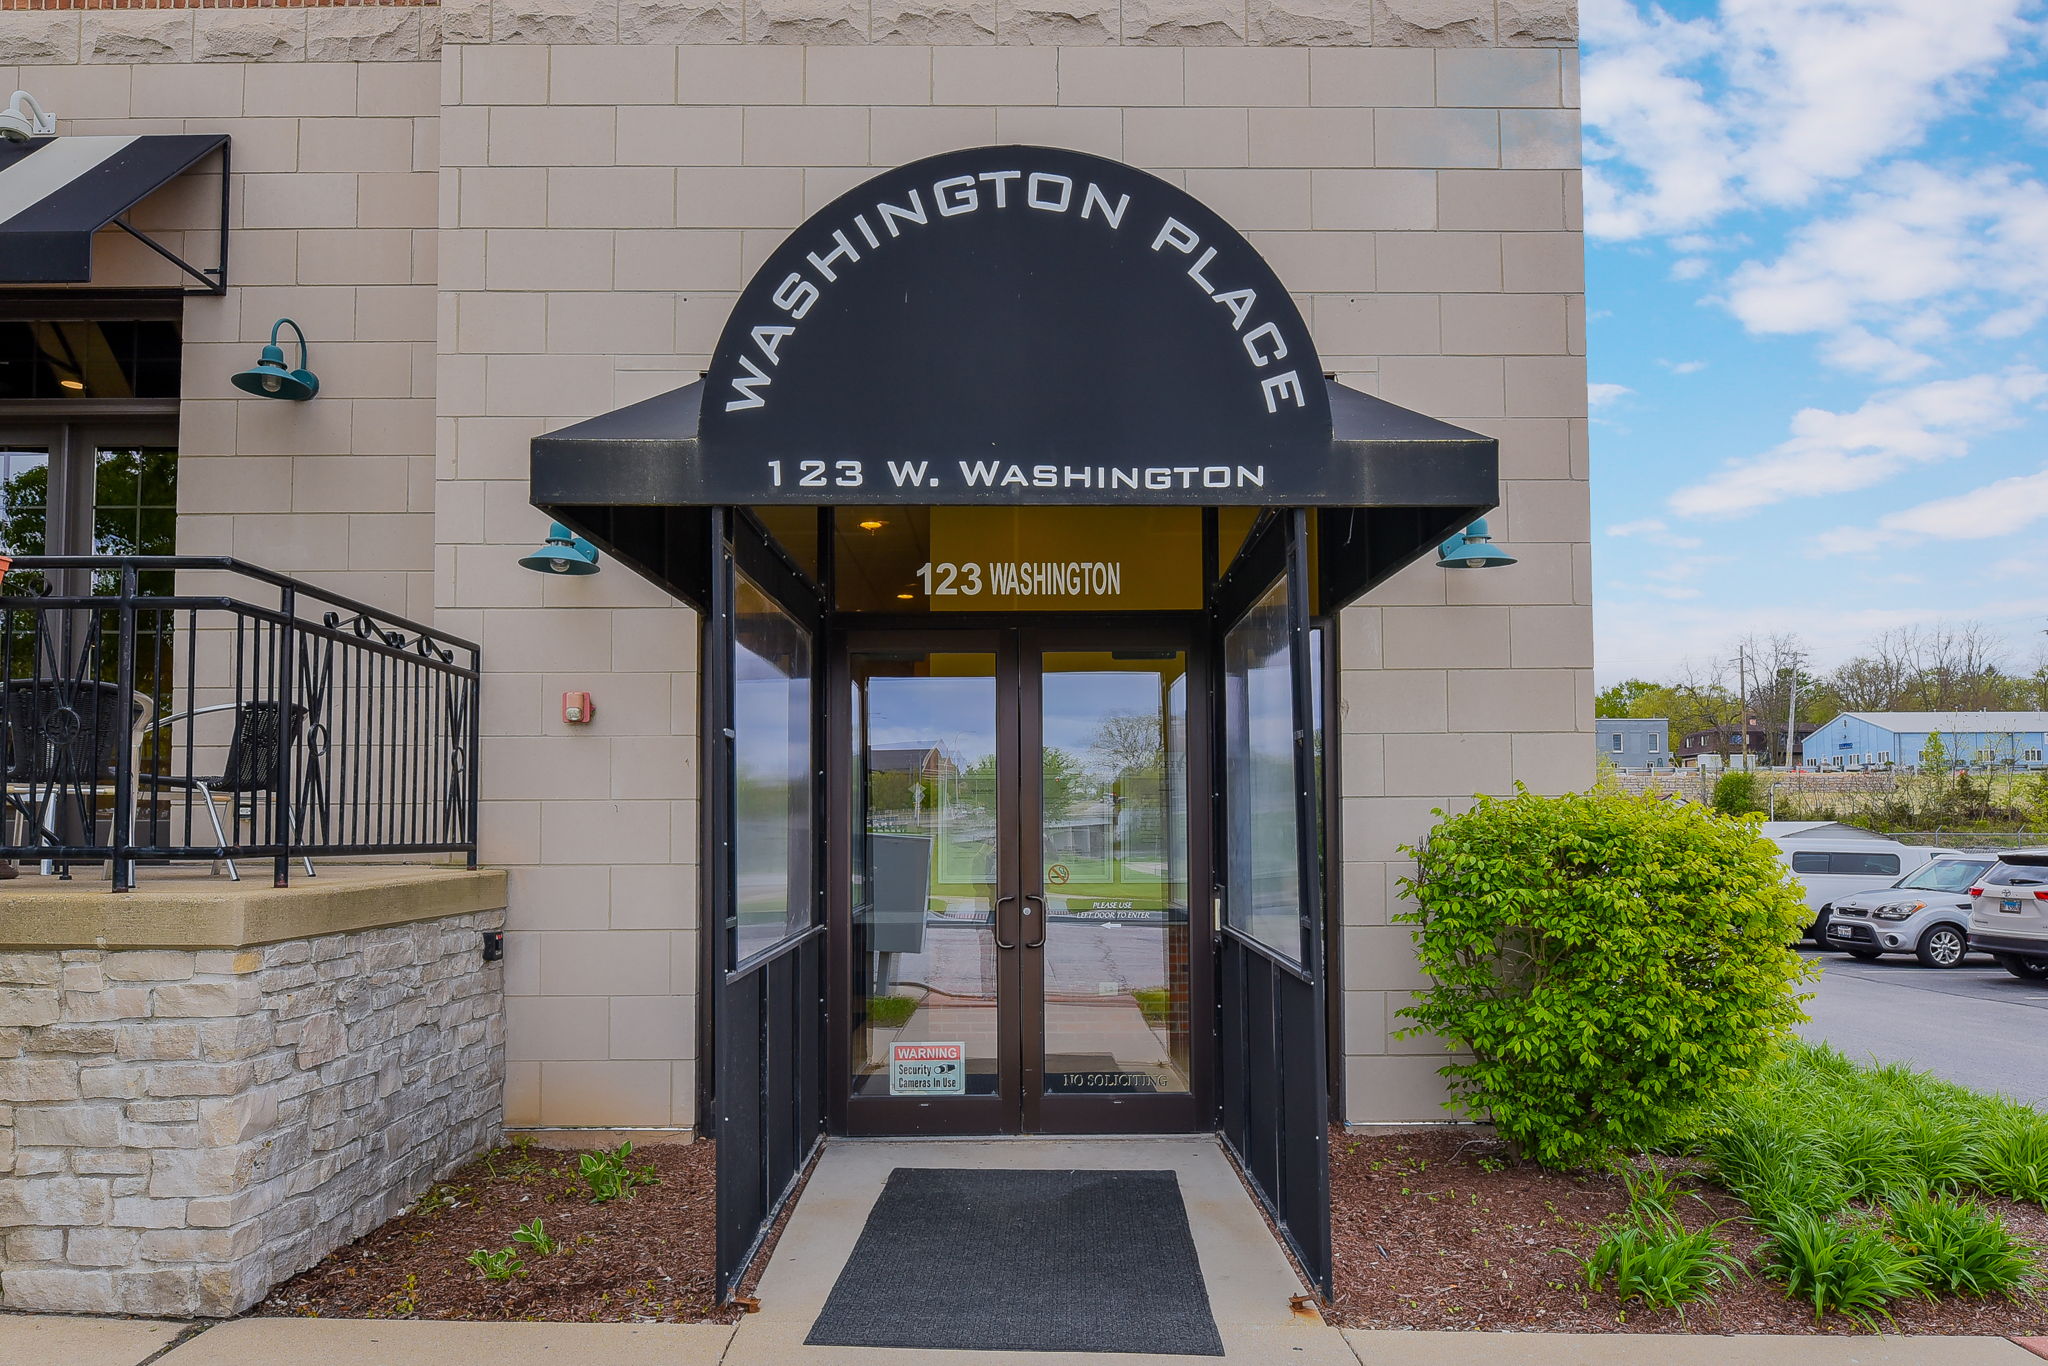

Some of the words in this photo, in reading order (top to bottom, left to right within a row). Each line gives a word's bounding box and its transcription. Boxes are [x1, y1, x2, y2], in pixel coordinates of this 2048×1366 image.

[725, 170, 1131, 412] WASHINGTON
[1150, 217, 1306, 414] PLACE
[767, 459, 863, 487] 123
[887, 460, 939, 488] W.
[958, 460, 1266, 490] WASHINGTON
[916, 562, 983, 596] 123
[989, 562, 1121, 596] WASHINGTON
[1092, 901, 1118, 909] PLEASE
[1118, 901, 1132, 909] USE
[1076, 911, 1093, 919] LEFT
[1094, 911, 1116, 919] DOOR
[1116, 911, 1127, 919] TO
[1127, 911, 1150, 919] ENTER
[897, 1047, 957, 1059] WARNING
[898, 1064, 932, 1076] Security
[898, 1077, 931, 1088] Cameras
[933, 1077, 941, 1088] In
[942, 1077, 957, 1088] Use
[1063, 1074, 1084, 1087] NO
[1087, 1074, 1168, 1087] SOLICITING
